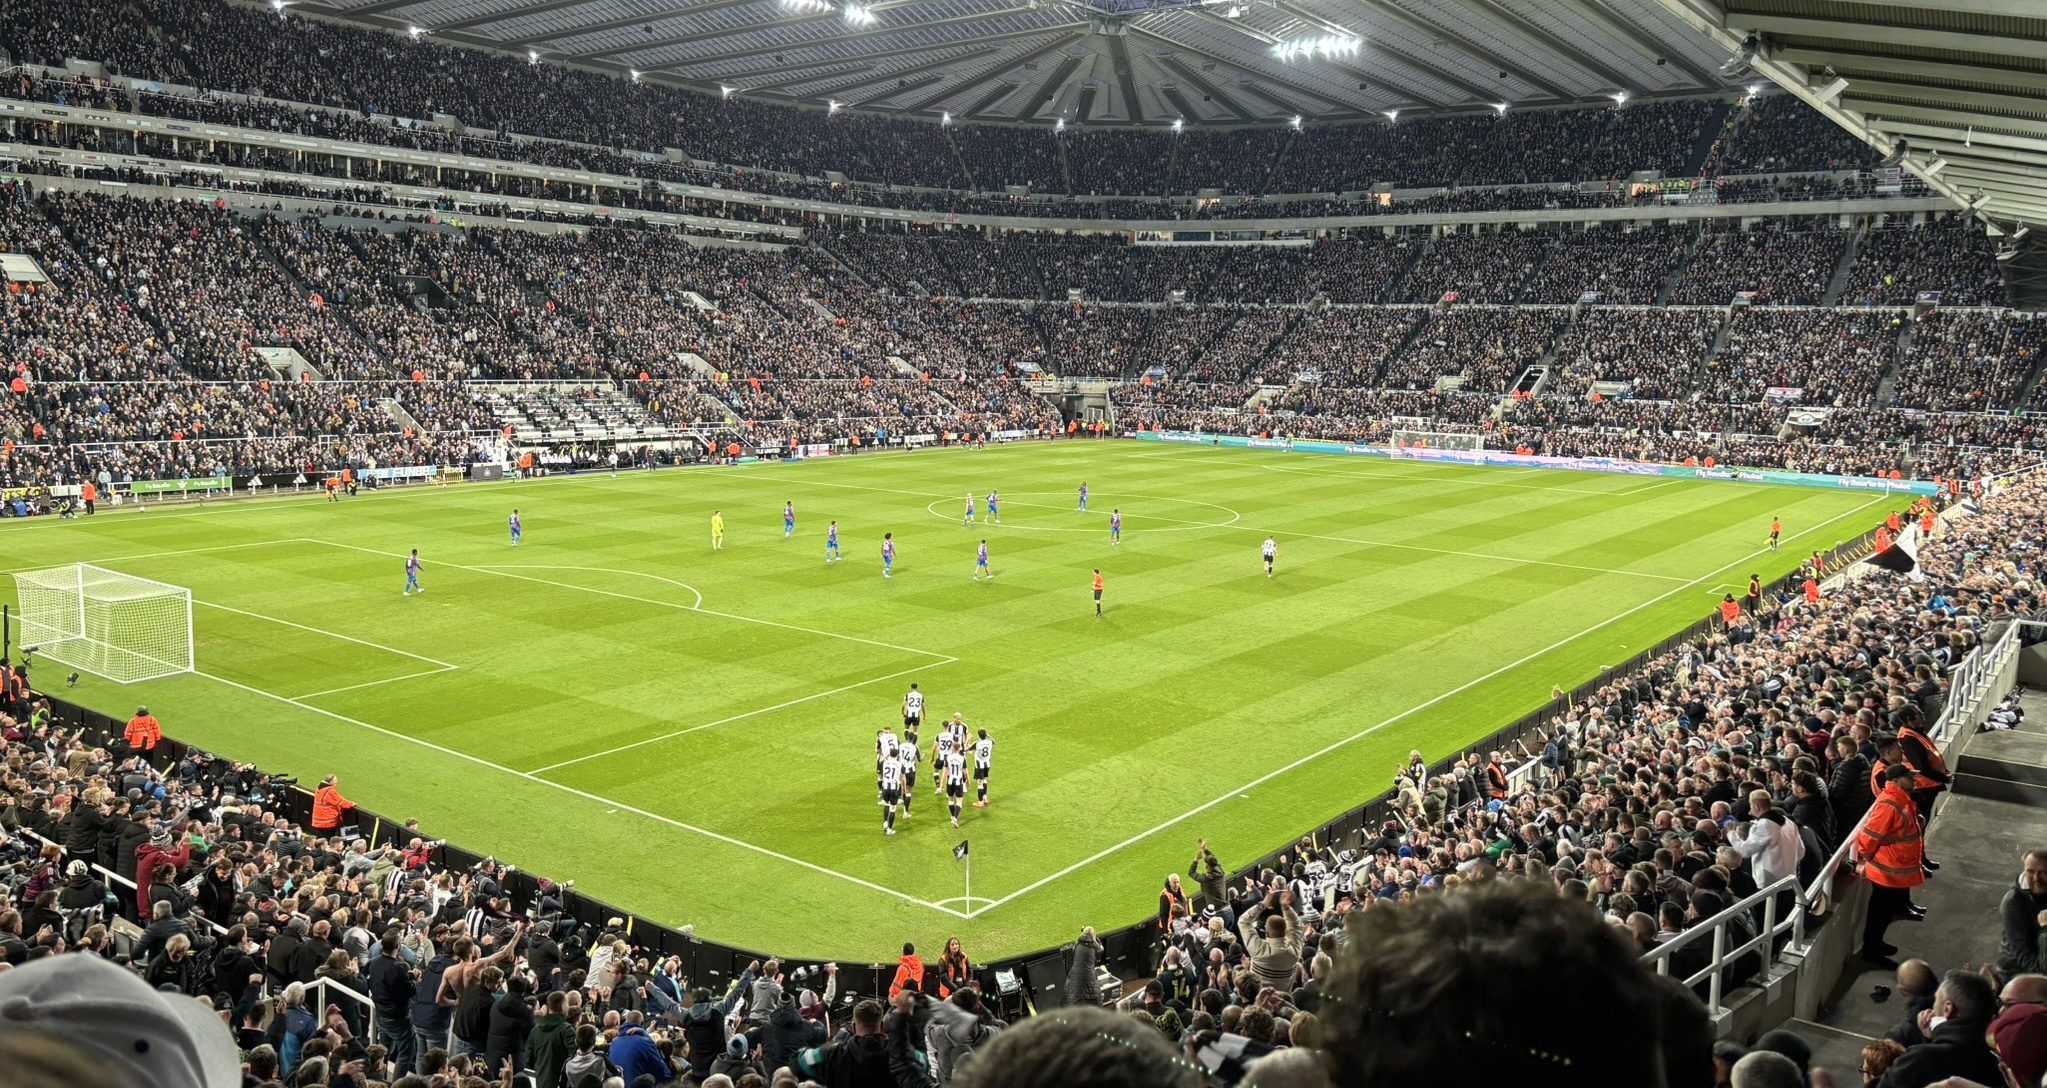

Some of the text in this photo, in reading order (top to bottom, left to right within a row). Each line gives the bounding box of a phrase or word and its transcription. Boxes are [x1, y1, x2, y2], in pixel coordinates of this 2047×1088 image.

[1696, 469, 1706, 478] Fly
[1838, 479, 1849, 487] Fly
[908, 697, 921, 708] 23
[888, 739, 896, 750] 5
[940, 740, 953, 751] 39
[901, 749, 911, 762] 14
[982, 746, 989, 758] 8
[884, 766, 896, 780] 21
[951, 764, 959, 776] 11
[1172, 977, 1190, 999] 14
